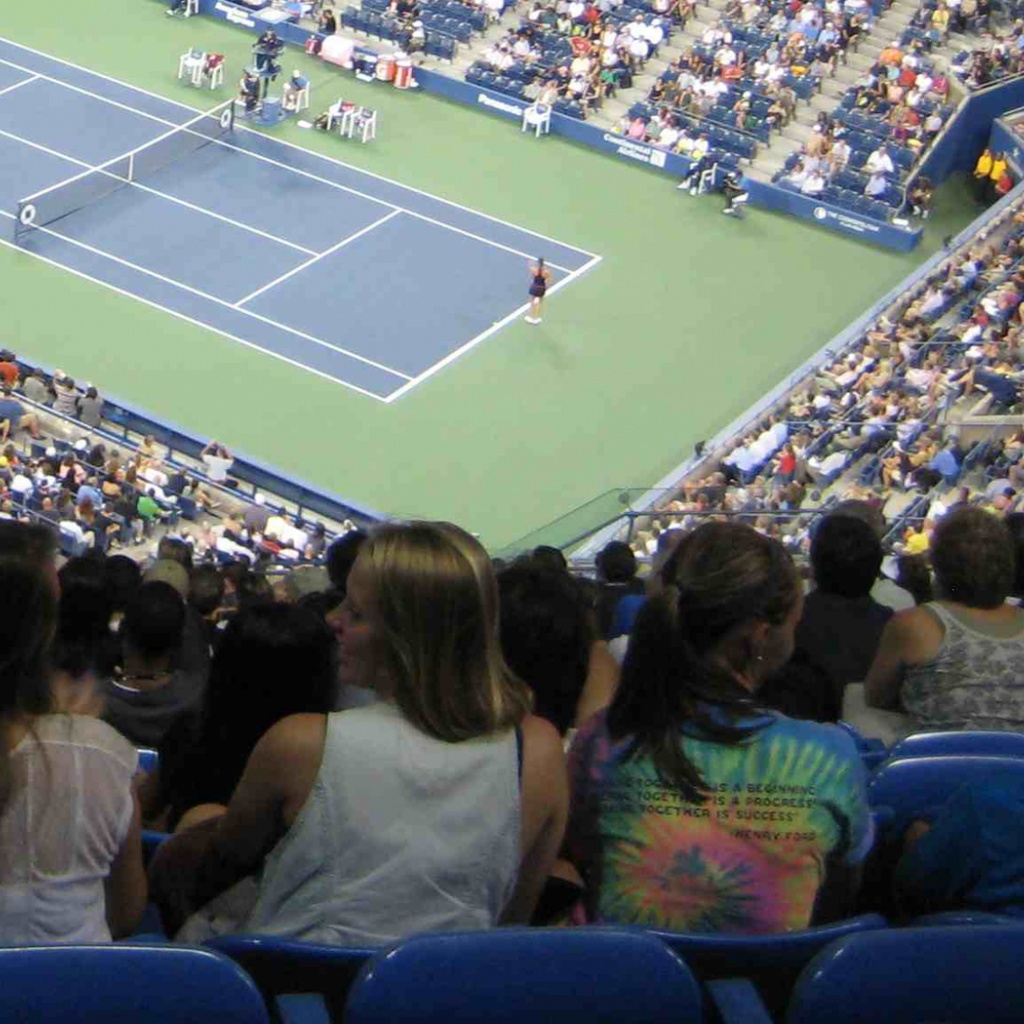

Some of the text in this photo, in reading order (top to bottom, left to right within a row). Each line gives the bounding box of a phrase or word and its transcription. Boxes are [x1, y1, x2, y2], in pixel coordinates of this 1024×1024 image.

[733, 783, 744, 793] A
[747, 782, 817, 796] BEGINNING
[713, 796, 726, 806] IS
[732, 796, 744, 807] A
[640, 804, 711, 819] TOGETHER
[717, 810, 729, 820] IS
